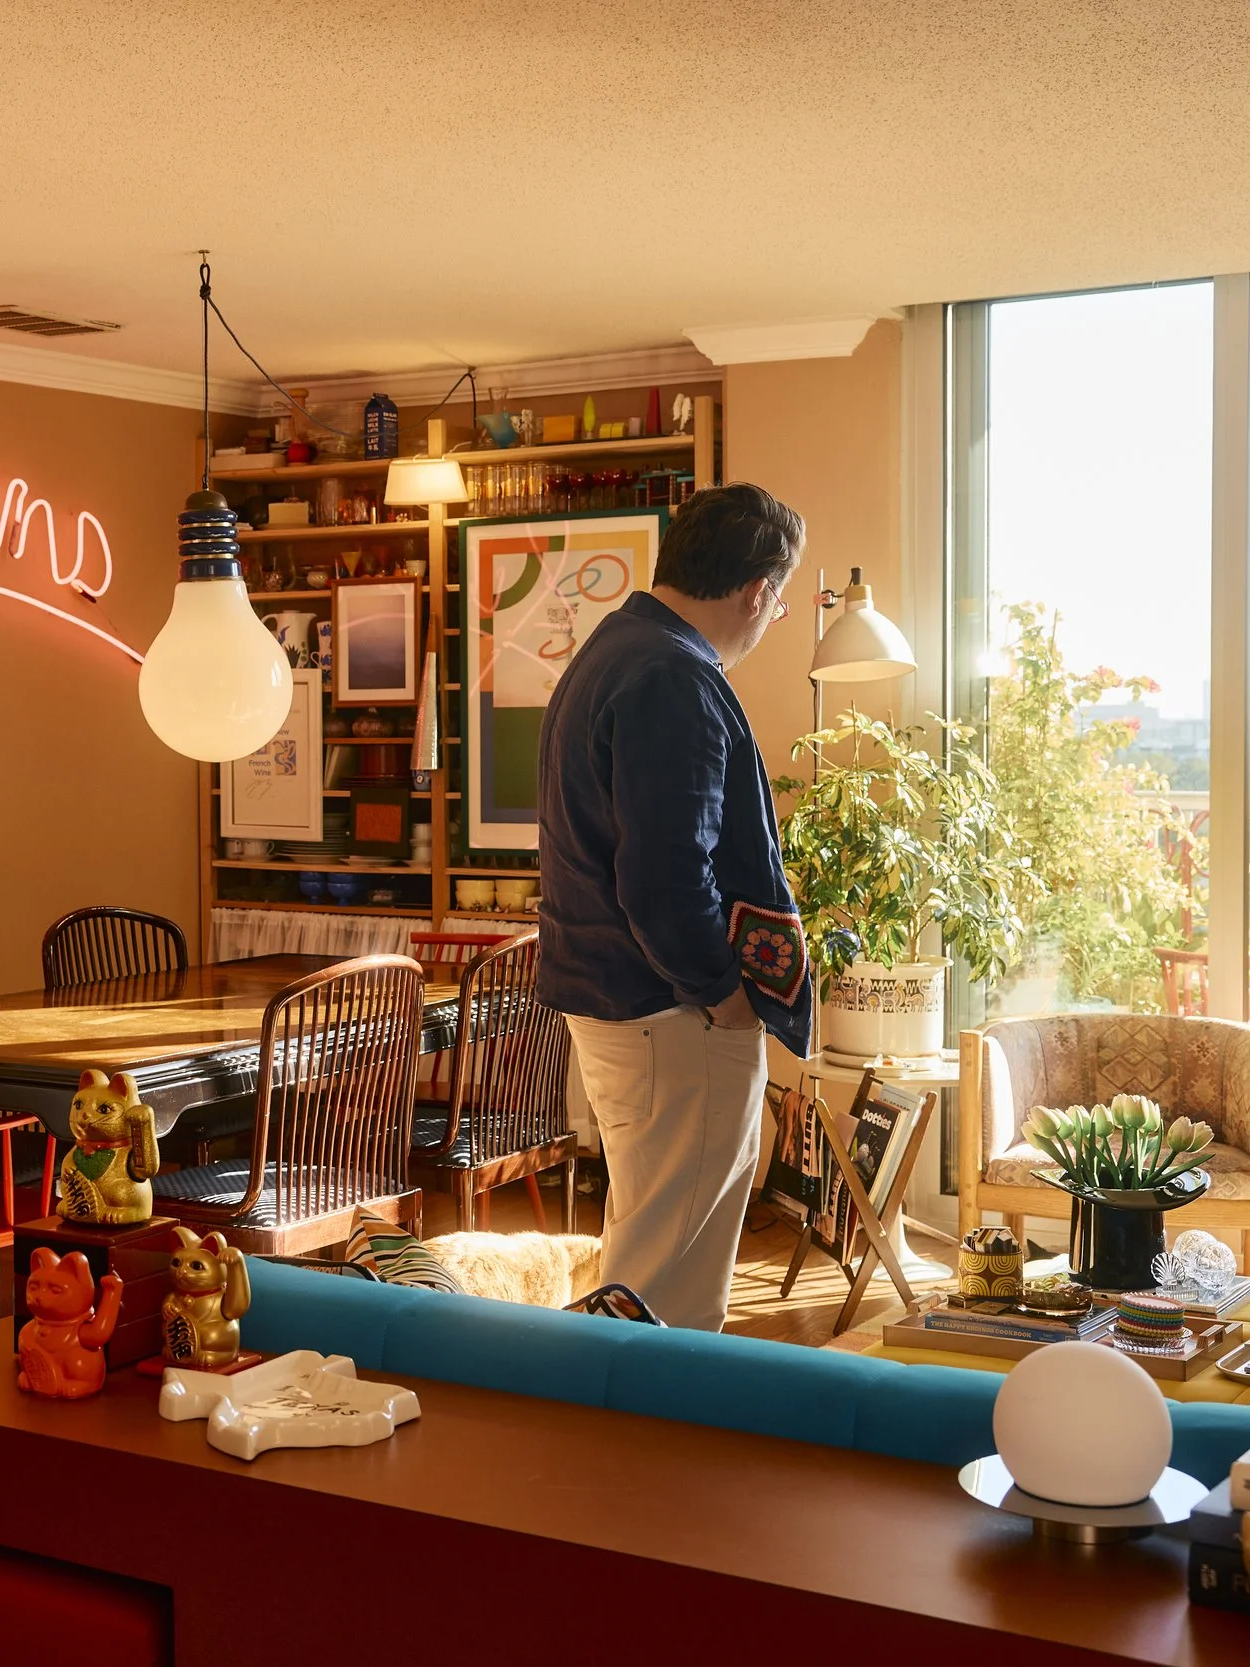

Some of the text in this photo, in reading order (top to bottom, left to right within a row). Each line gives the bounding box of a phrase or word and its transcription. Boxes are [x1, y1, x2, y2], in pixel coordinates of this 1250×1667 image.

[248, 759, 271, 767] French
[253, 768, 271, 776] Wine
[930, 1320, 943, 1328] THE
[944, 1322, 966, 1331] HAPPY
[995, 1328, 1032, 1338] COOKBOOK
